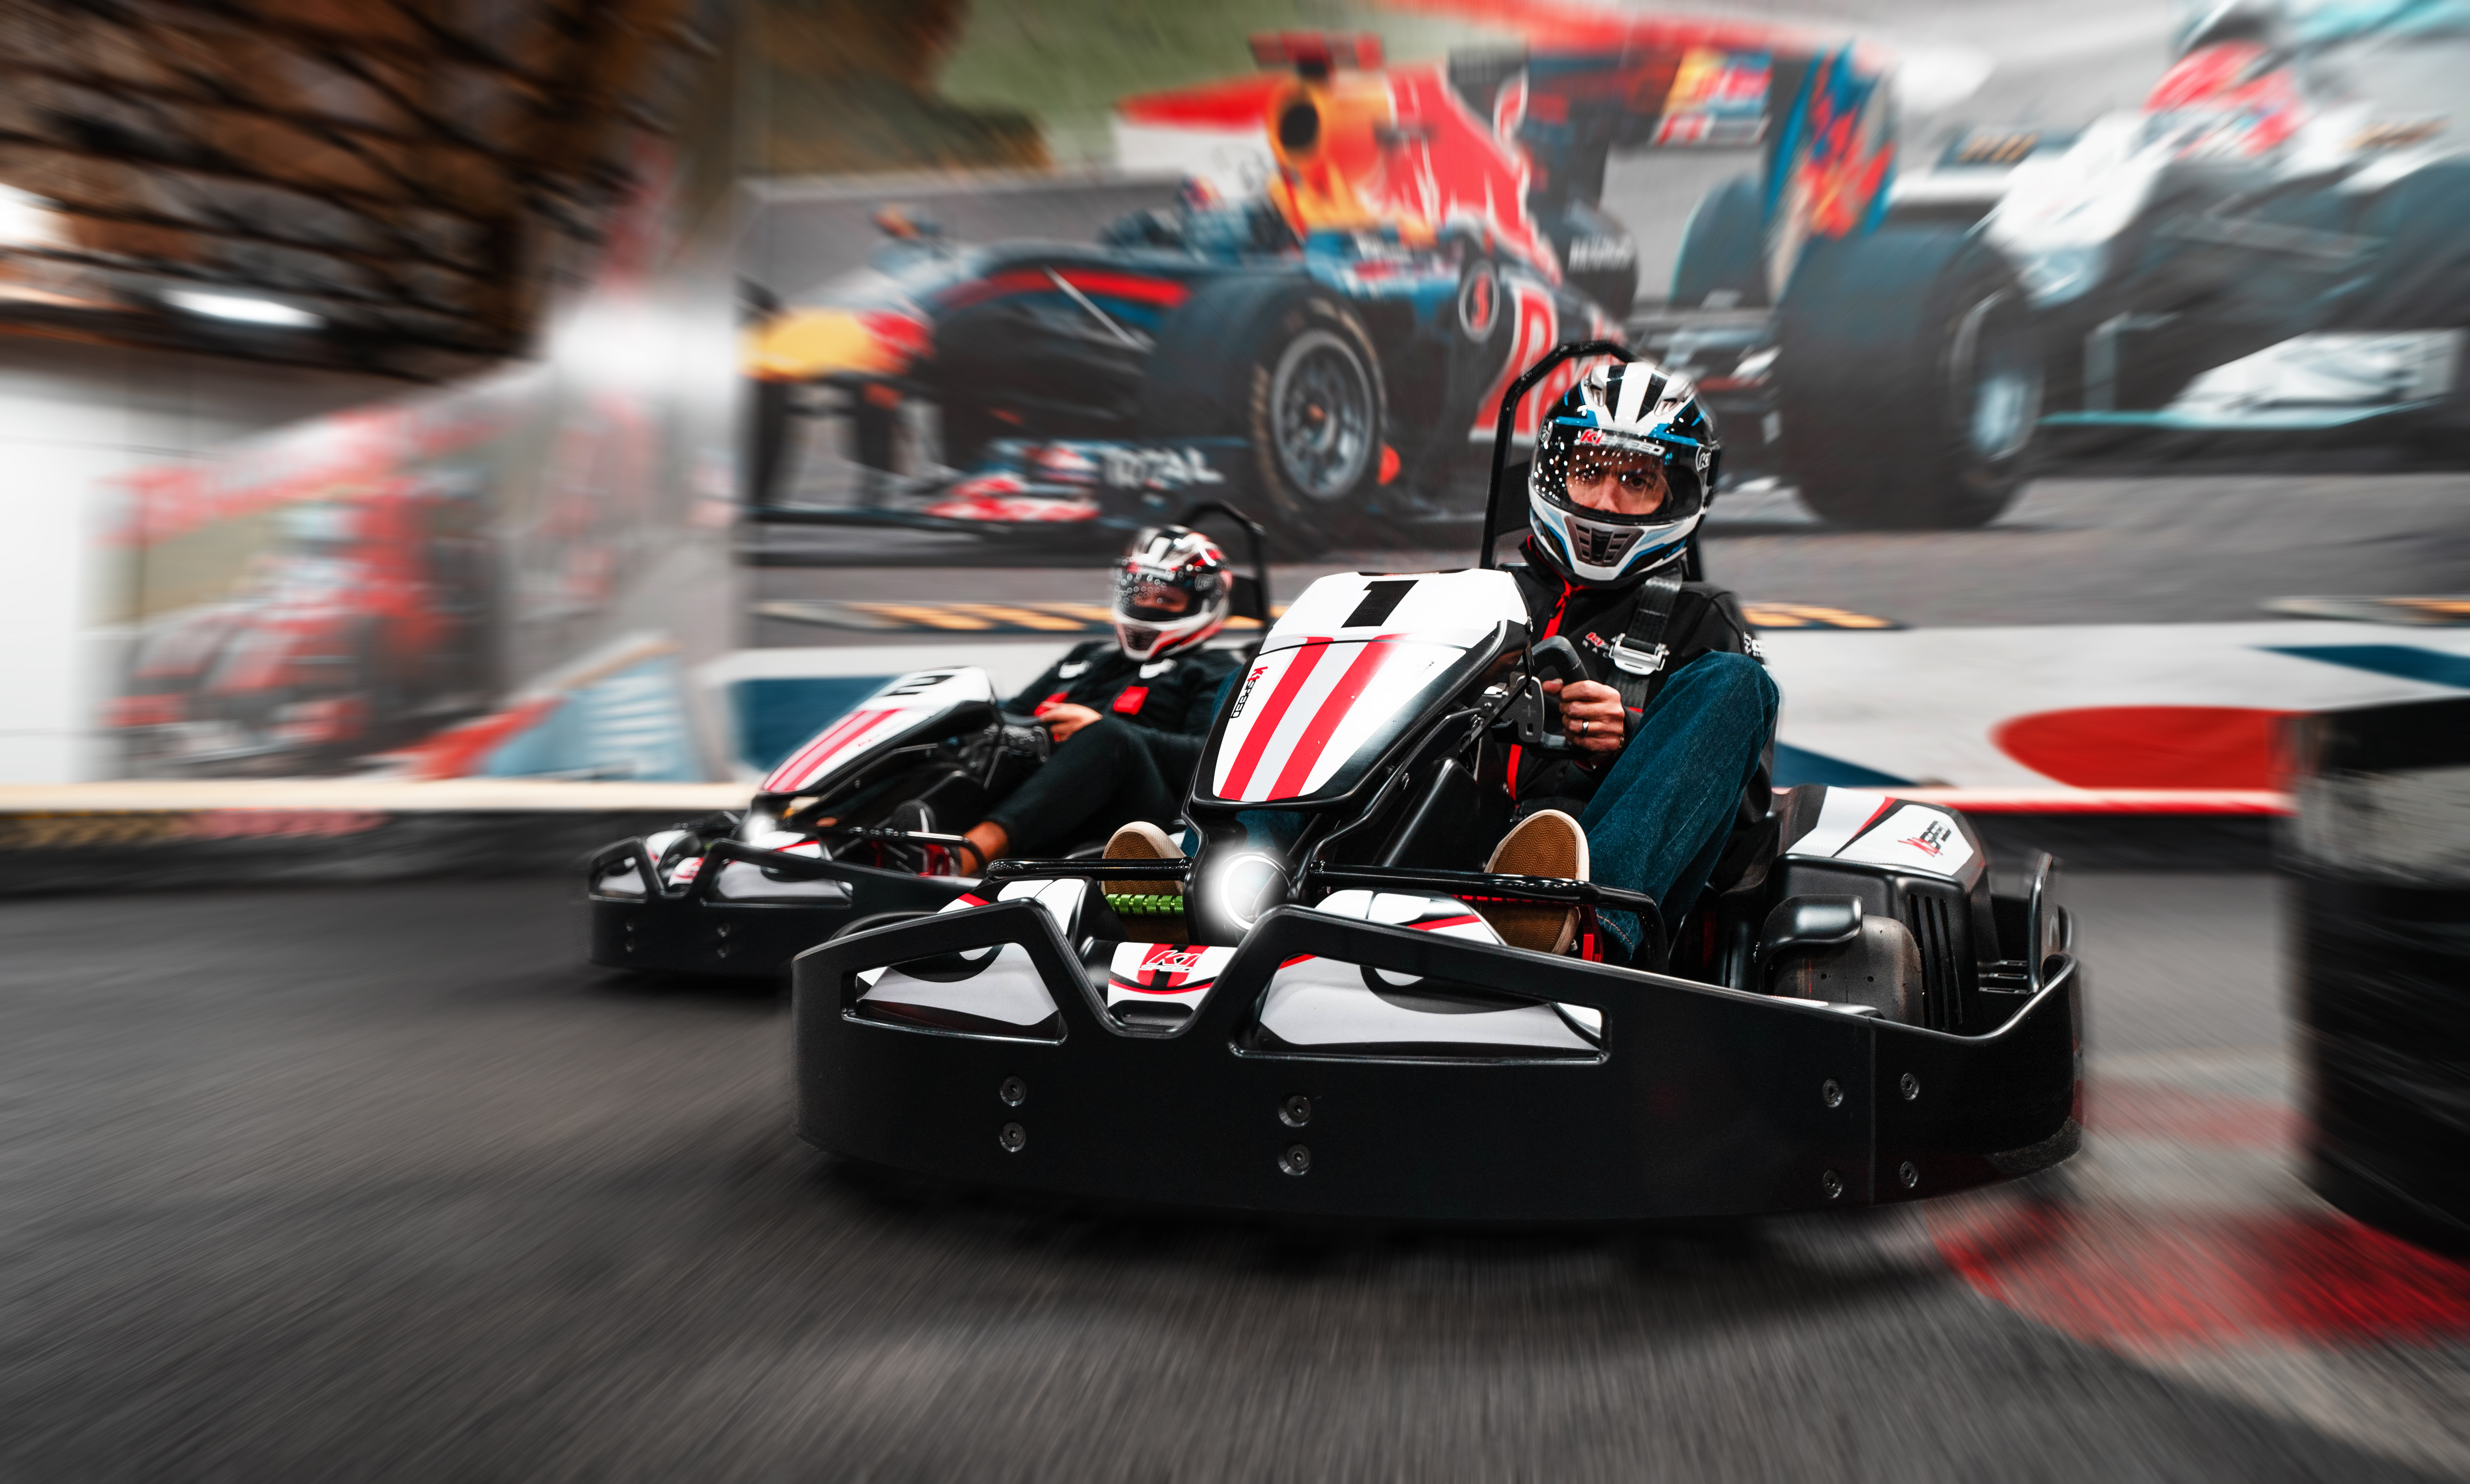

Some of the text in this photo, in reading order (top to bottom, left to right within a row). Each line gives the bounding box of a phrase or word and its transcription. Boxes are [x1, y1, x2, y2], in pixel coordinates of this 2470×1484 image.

[1341, 580, 1420, 628] 1
[1145, 950, 1202, 967] K1
[1137, 964, 1195, 973] SPEED
